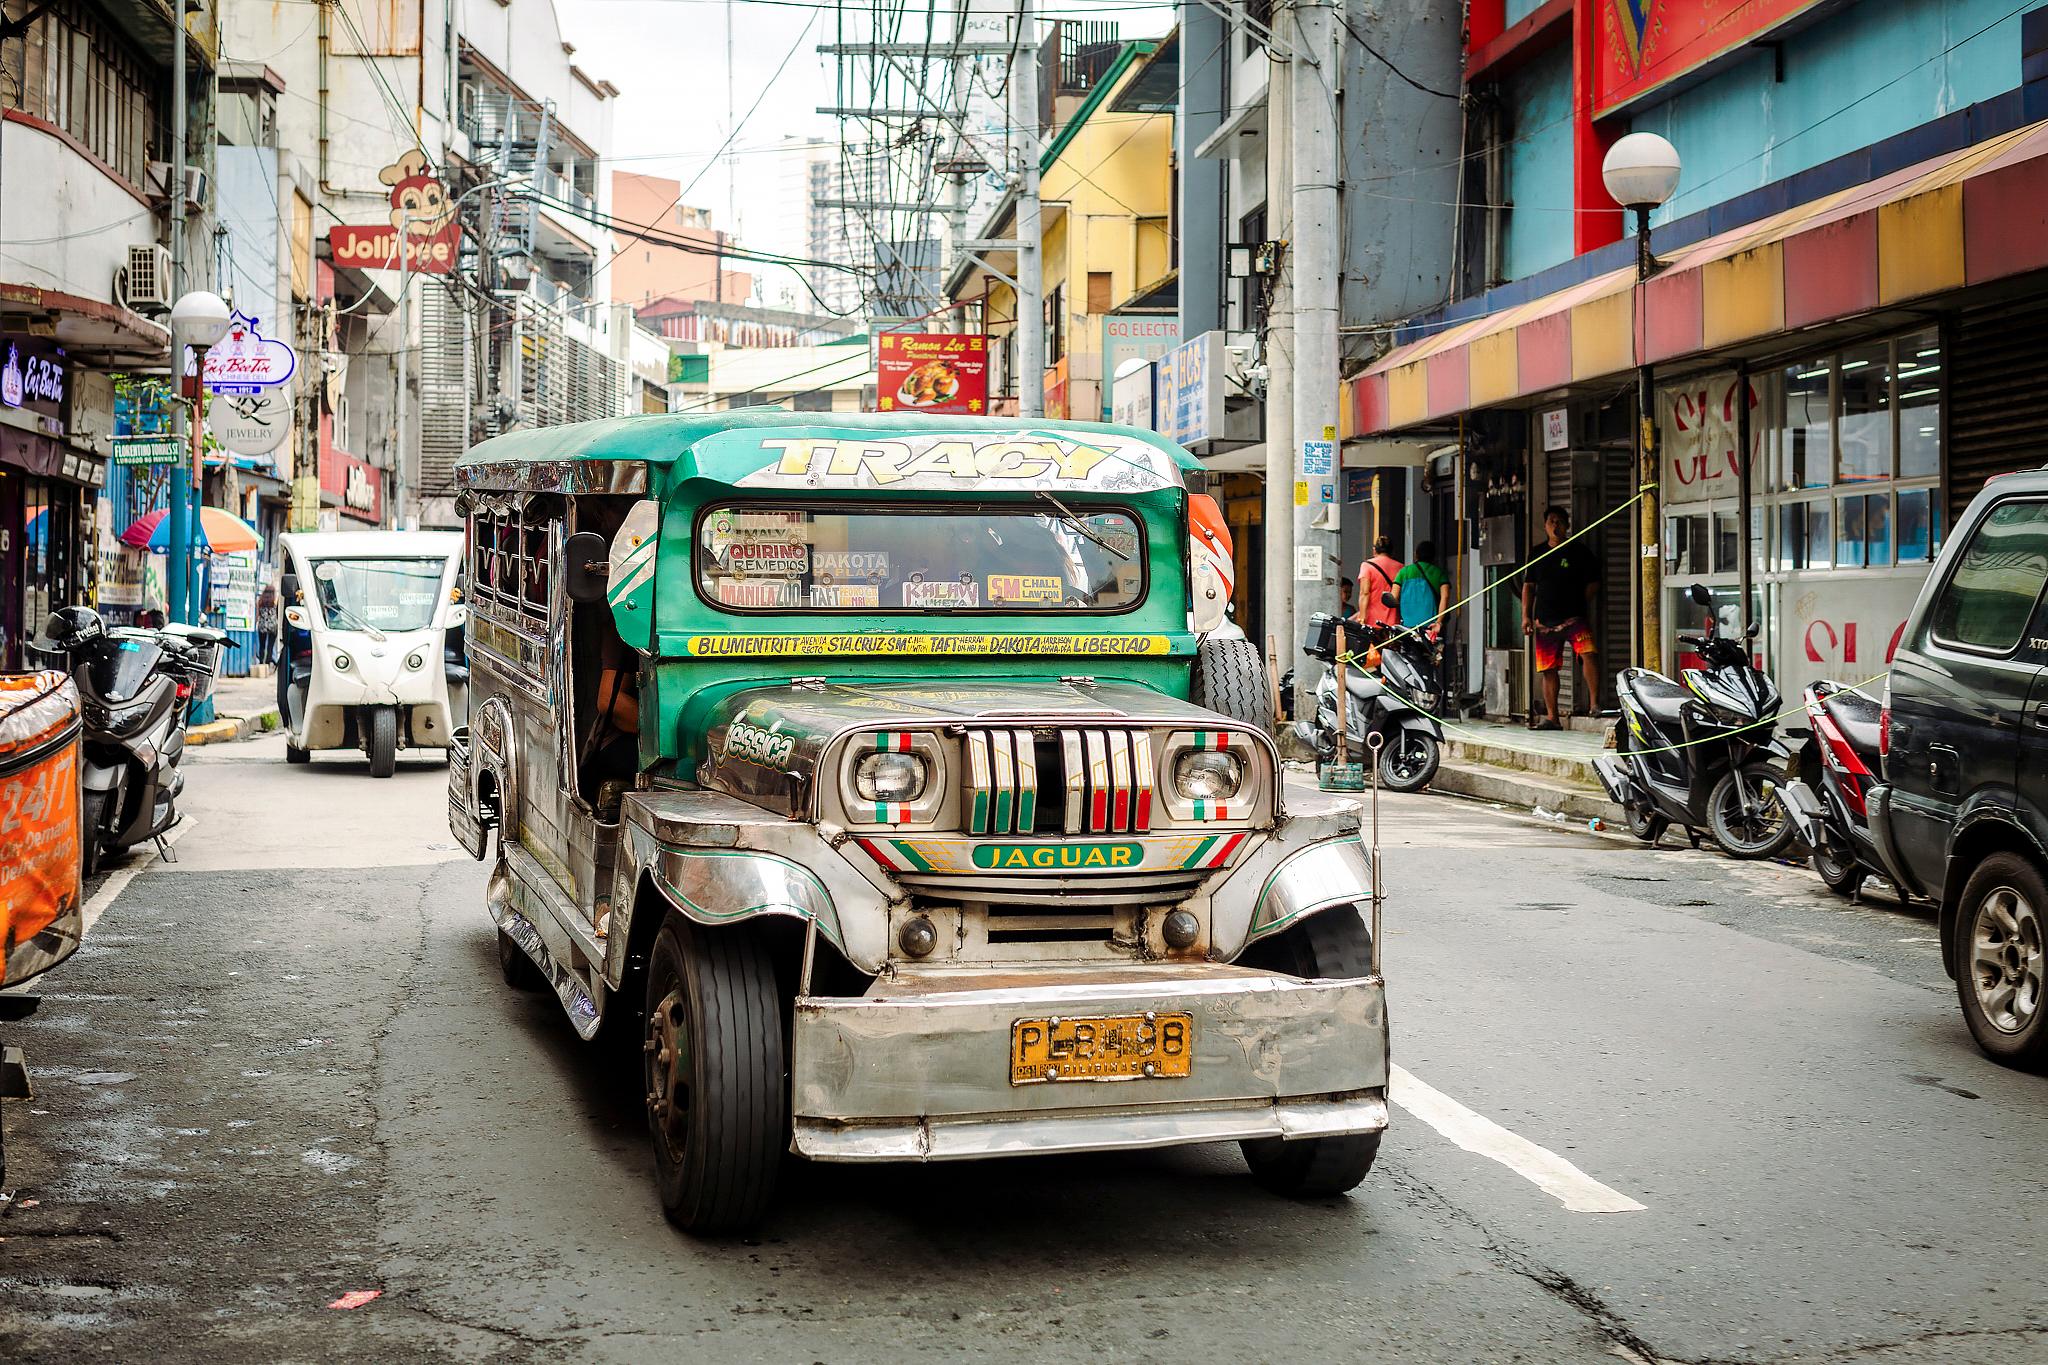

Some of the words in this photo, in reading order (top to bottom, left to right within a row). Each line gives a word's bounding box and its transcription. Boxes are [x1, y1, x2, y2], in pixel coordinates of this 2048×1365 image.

[337, 232, 450, 263] Jollibee
[1108, 323, 1129, 338] GQ
[900, 336, 941, 351] Ramon
[943, 337, 966, 352] Lee
[1178, 342, 1201, 389] HCS
[219, 385, 237, 395] Since
[238, 385, 254, 395] 1912
[226, 428, 273, 440] JEWELRY
[114, 443, 150, 457] FLORENTINO
[150, 443, 172, 456] TORRES
[760, 439, 1122, 485] TRACY
[730, 544, 806, 559] QUIRINO
[734, 560, 806, 573] REMEDIOS
[813, 553, 888, 569] DAKOTA
[721, 584, 777, 606] MANILA
[774, 582, 801, 607] ZOO
[810, 586, 840, 606] TAFT
[905, 583, 979, 605] KALAW
[991, 577, 1020, 599] SM
[1022, 589, 1060, 600] LAWTON
[698, 637, 800, 655] BLUMENTRITT
[800, 636, 827, 645] AVENIDA
[930, 636, 960, 653] TAFT
[990, 637, 1041, 653] DAKOTA
[801, 645, 824, 654] RECTO
[1, 754, 73, 836] 24/7
[990, 846, 1132, 869] JAGUAR
[1063, 1062, 1138, 1074] PILIPINAS
